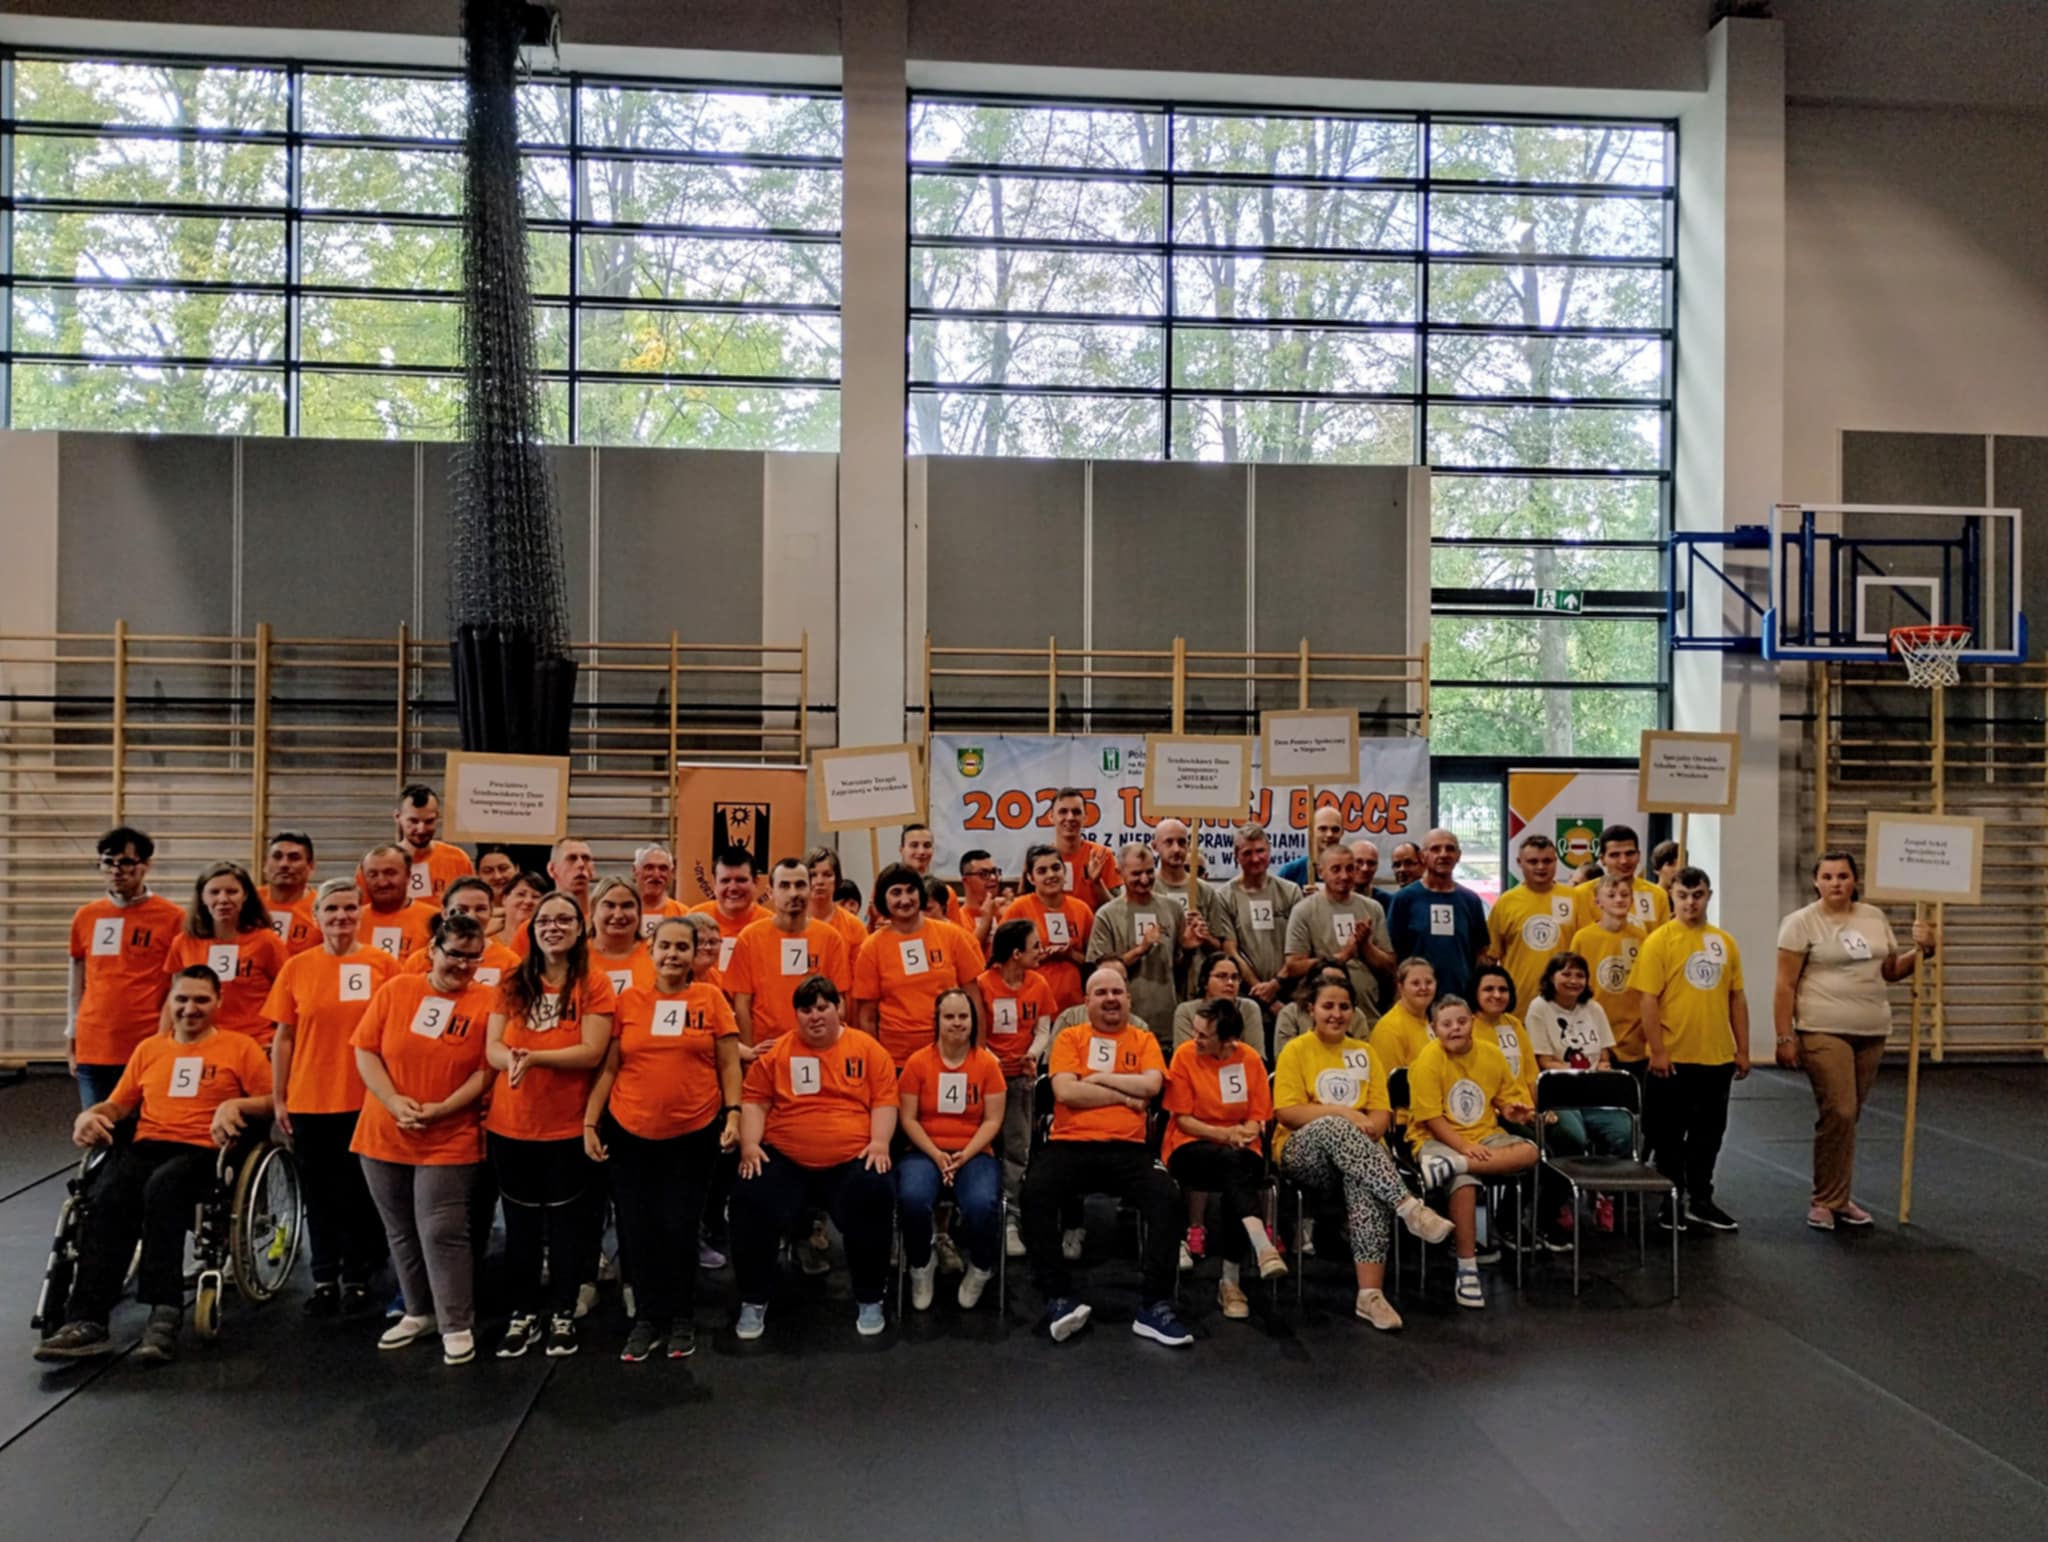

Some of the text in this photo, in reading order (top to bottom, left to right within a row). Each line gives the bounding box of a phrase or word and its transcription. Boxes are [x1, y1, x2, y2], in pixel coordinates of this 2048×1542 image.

[412, 873, 424, 890] 8
[1558, 903, 1569, 917] 9
[1639, 898, 1649, 913] 9
[1253, 908, 1271, 922] 12
[1432, 909, 1450, 924] 13
[102, 926, 115, 945] 2
[1052, 920, 1064, 936] 2
[1711, 942, 1722, 957] 9
[1844, 937, 1867, 951] 14
[218, 955, 230, 973] 3
[790, 949, 803, 966] 7
[906, 949, 919, 966] 5
[348, 973, 362, 991] 6
[612, 979, 626, 995] 7
[423, 1007, 441, 1027] 3
[663, 1010, 678, 1027] 4
[1001, 1009, 1011, 1026] 1
[1498, 1033, 1518, 1049] 10
[1579, 1029, 1598, 1046] 14
[1098, 1046, 1109, 1062] 5
[1344, 1053, 1368, 1069] 10
[176, 1068, 191, 1088] 5
[801, 1066, 813, 1084] 1
[1229, 1075, 1242, 1094] 5
[945, 1085, 959, 1104] 4
